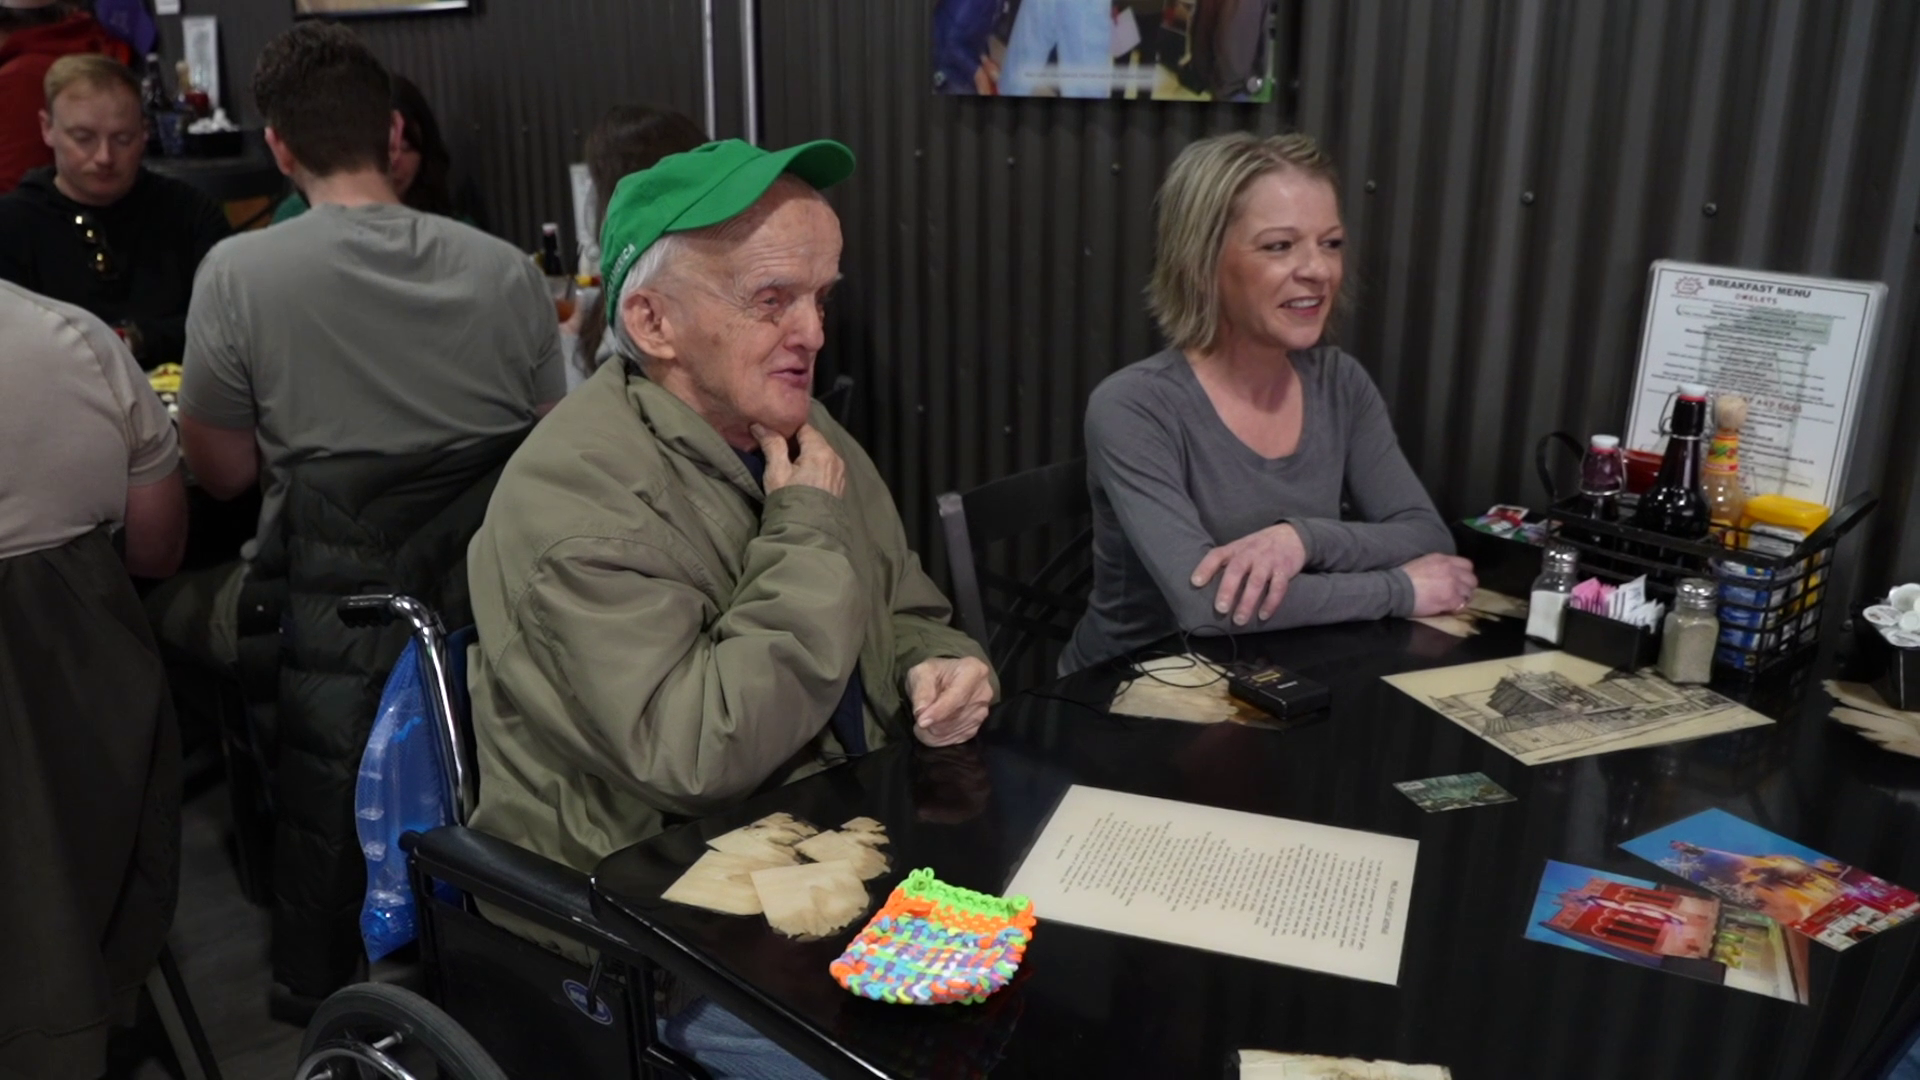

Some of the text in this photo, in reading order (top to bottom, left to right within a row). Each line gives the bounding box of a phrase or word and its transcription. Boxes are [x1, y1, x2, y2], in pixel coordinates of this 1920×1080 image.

[1708, 279, 1774, 294] BREAKFAST
[1776, 287, 1812, 299] MENU
[1734, 293, 1778, 305] OMELETS
